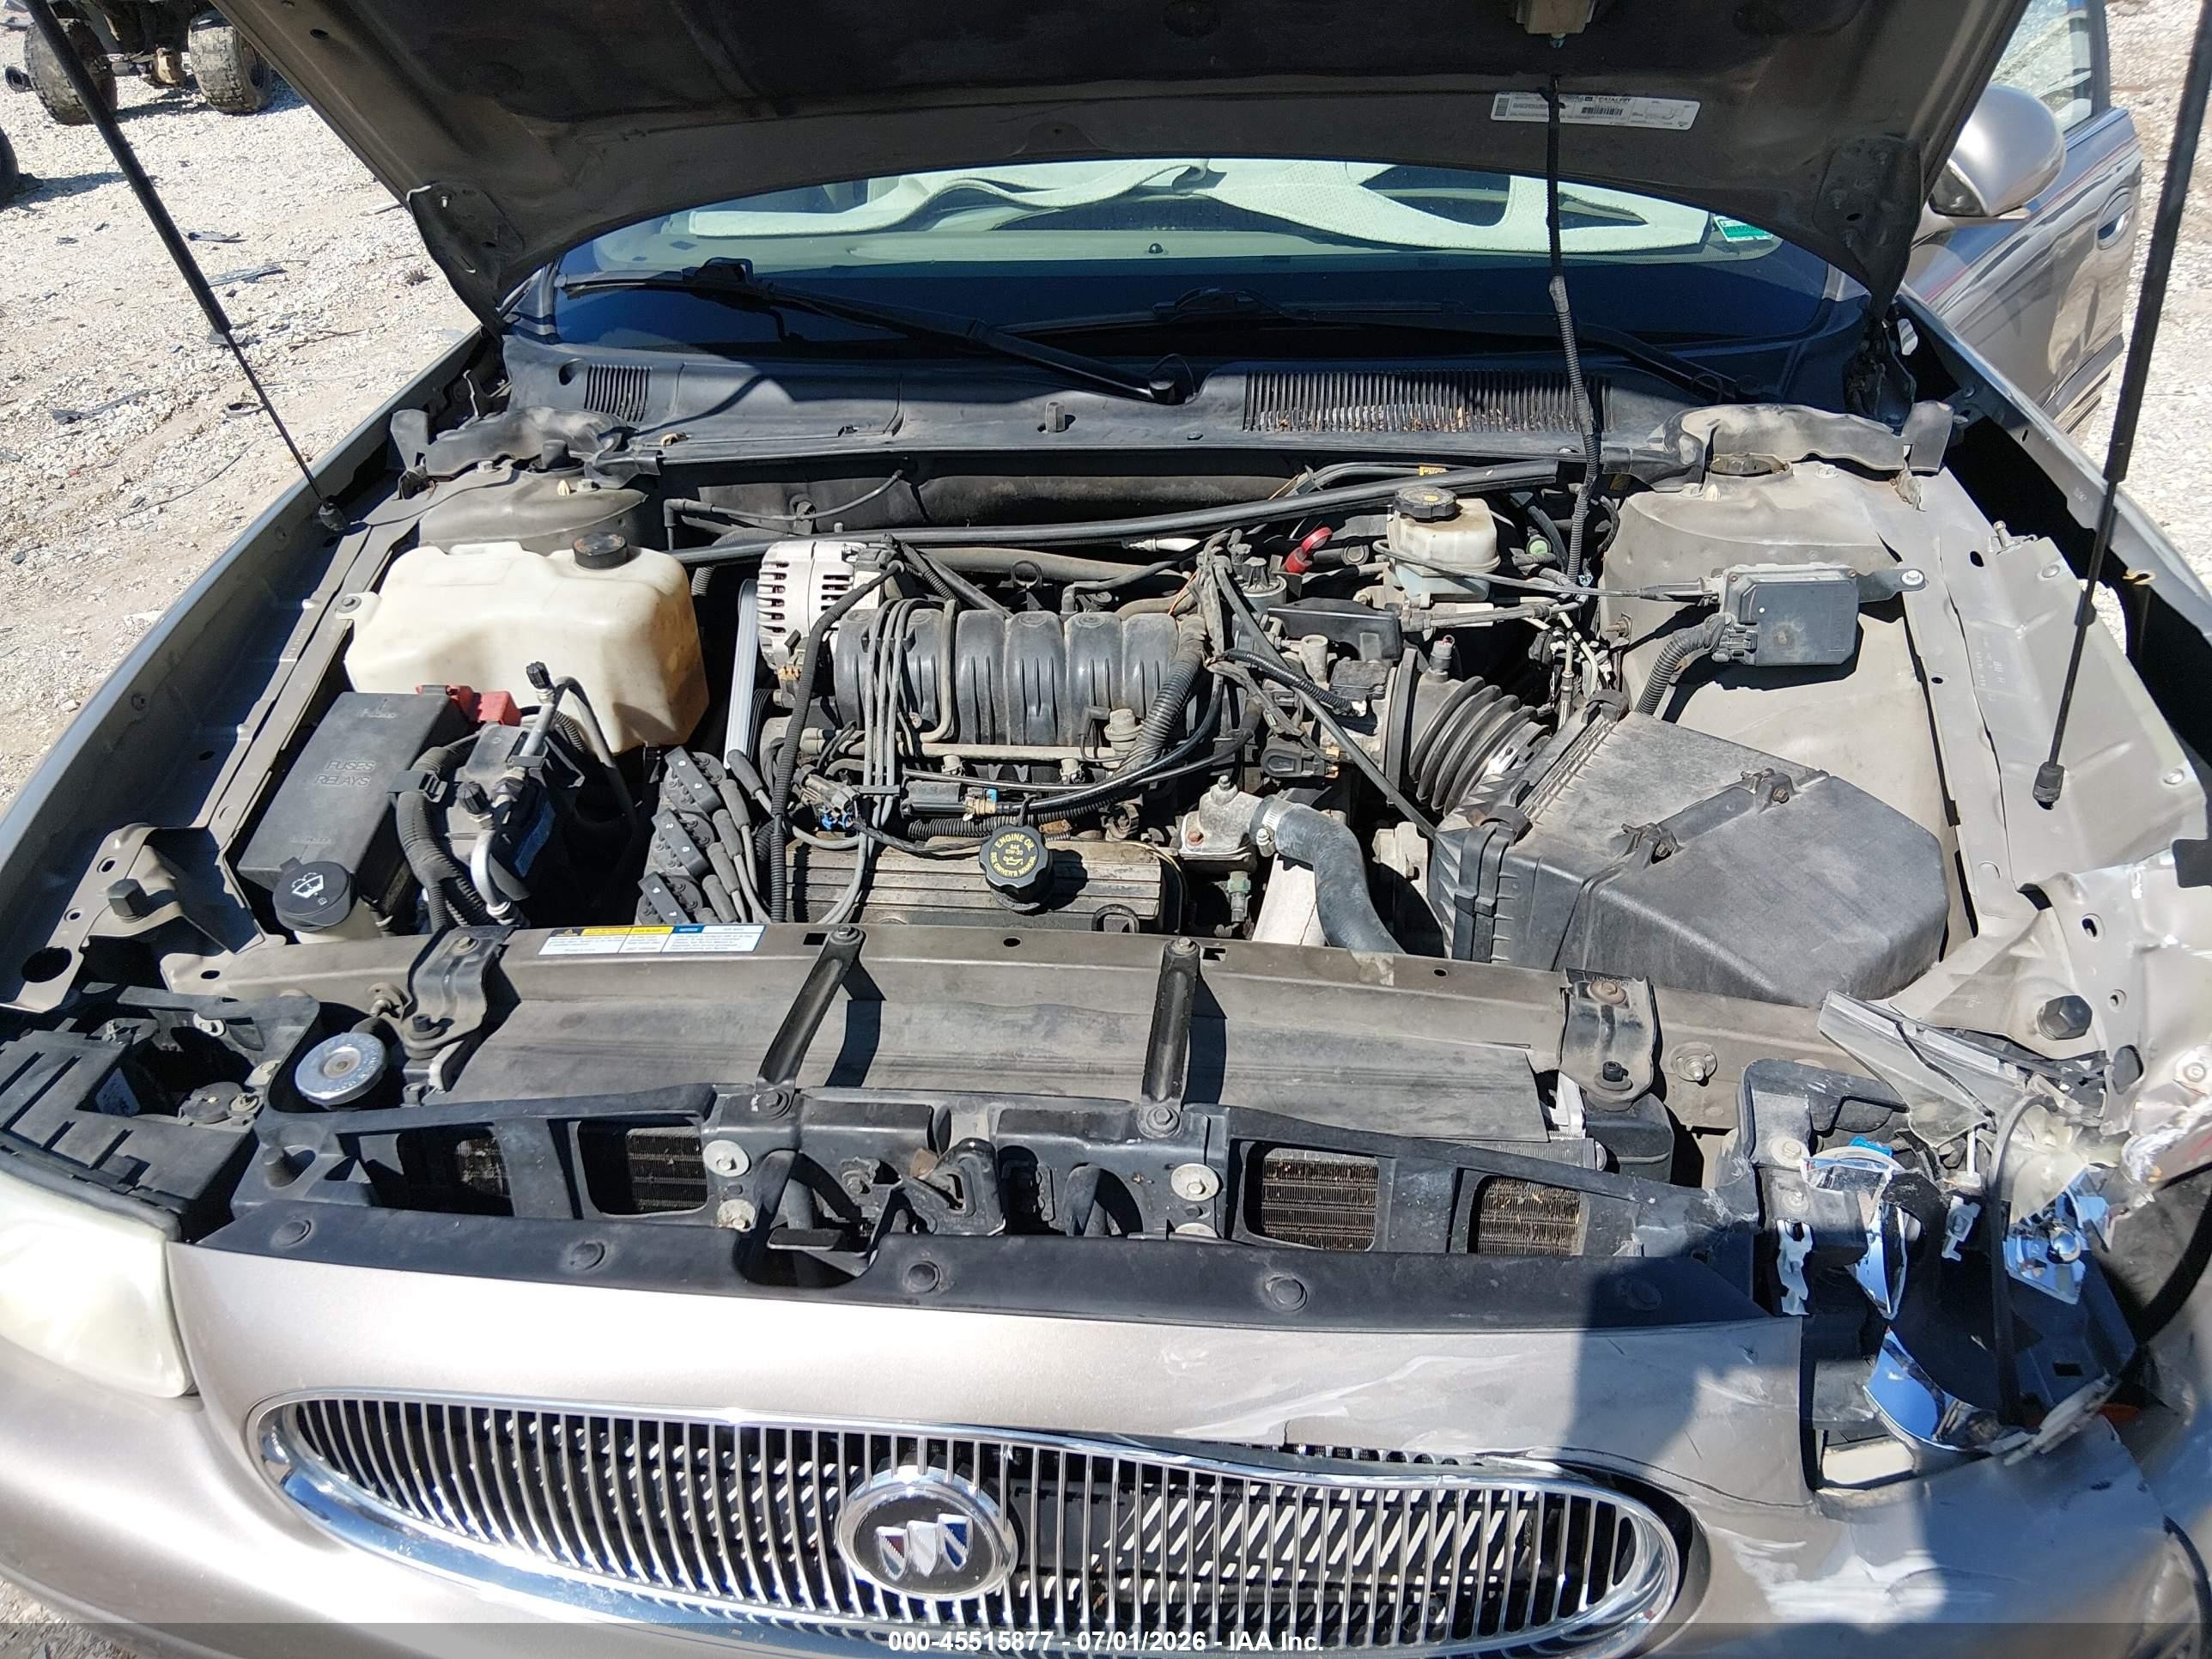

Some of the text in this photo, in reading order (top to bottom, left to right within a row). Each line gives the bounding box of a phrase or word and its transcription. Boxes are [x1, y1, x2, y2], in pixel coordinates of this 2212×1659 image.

[324, 760, 377, 772] FUSES
[314, 774, 371, 787] RELAYS
[994, 833, 1035, 852] ENGINE OIL
